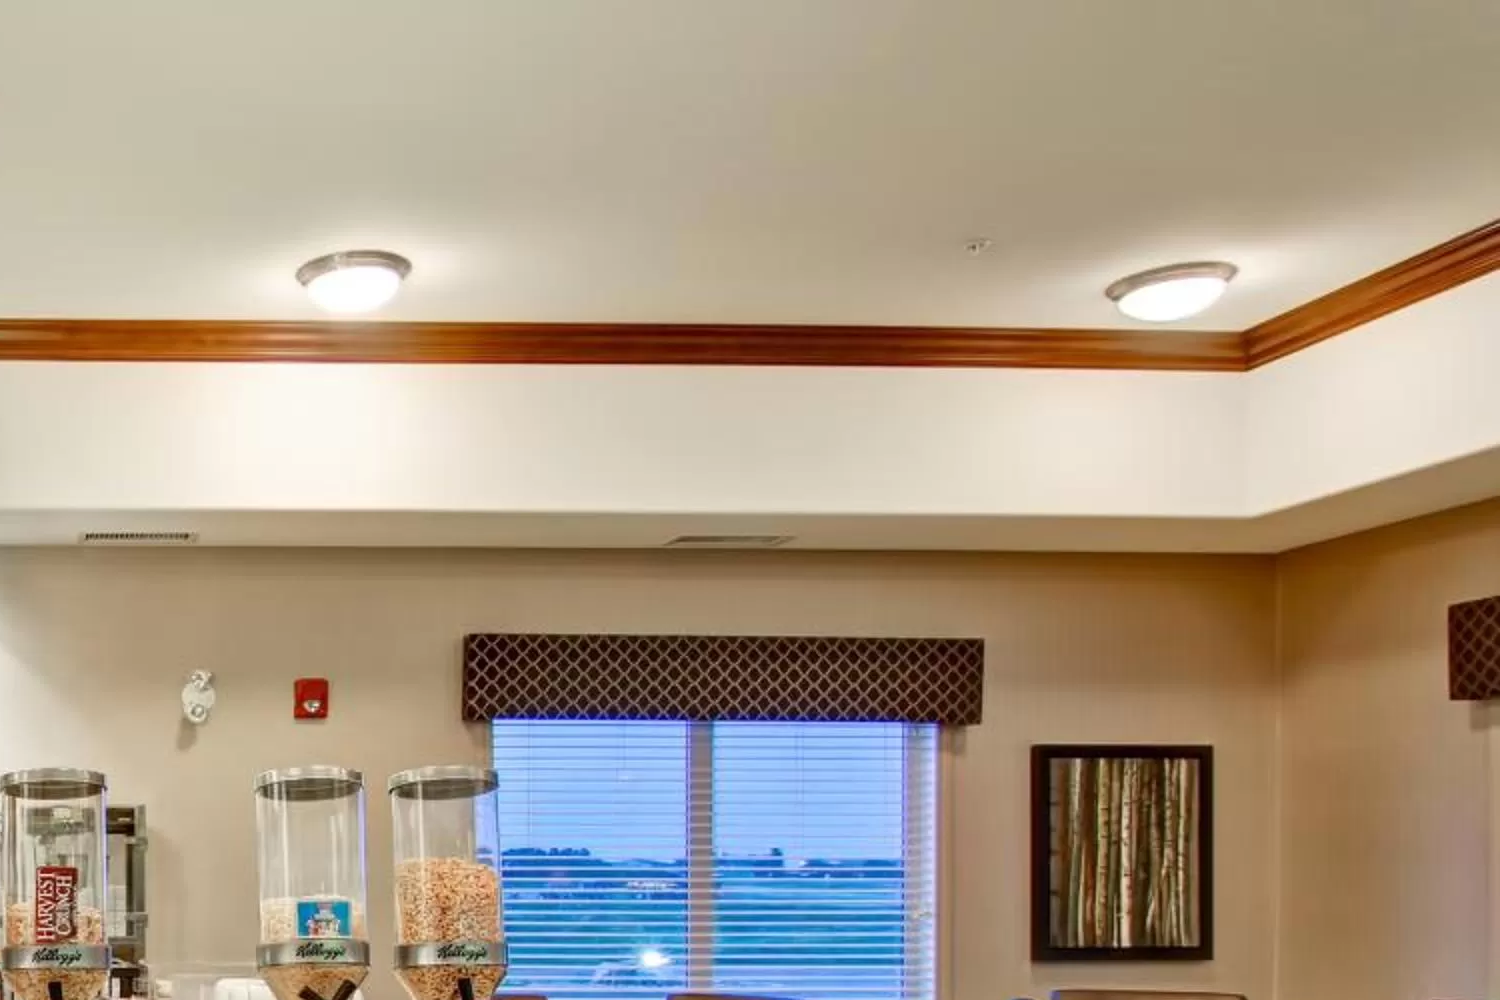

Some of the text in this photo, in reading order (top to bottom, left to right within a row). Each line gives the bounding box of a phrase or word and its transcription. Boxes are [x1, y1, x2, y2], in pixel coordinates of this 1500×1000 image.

[37, 872, 55, 940] HARVEST
[32, 947, 82, 965] Kellogg's
[296, 941, 346, 961] Kellogg's
[437, 943, 488, 962] Kellogg's
